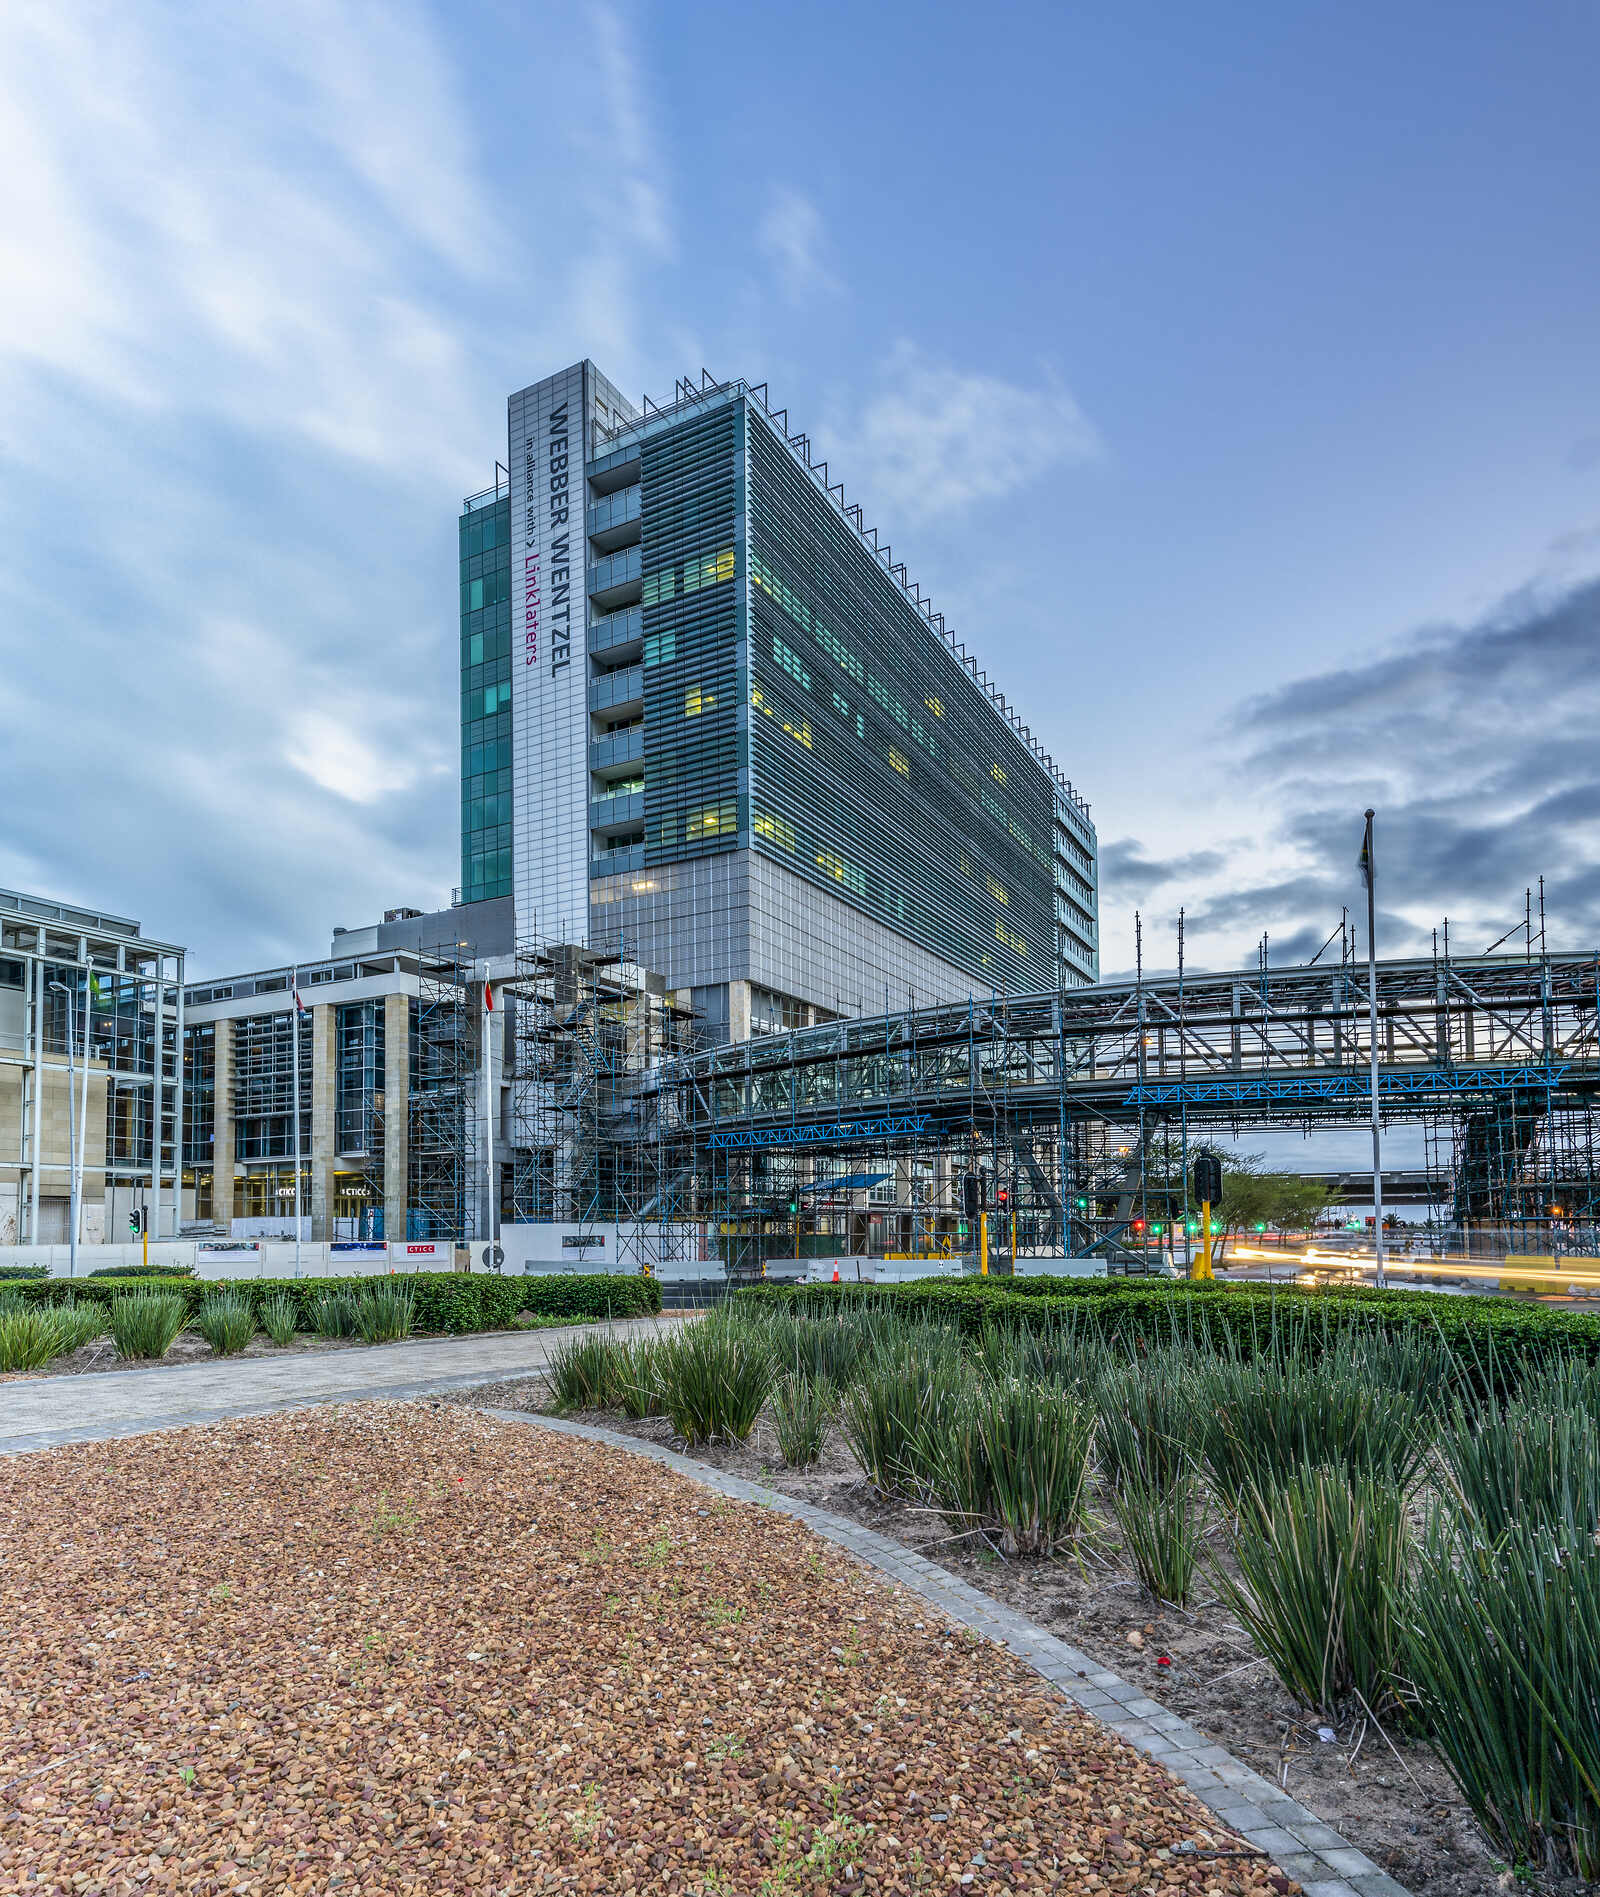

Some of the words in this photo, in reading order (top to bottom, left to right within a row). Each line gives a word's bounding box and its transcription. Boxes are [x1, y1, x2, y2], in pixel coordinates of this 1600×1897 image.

[526, 436, 535, 451] in
[526, 452, 536, 502] alliance
[550, 401, 569, 530] WEBBER
[527, 505, 536, 536] with
[525, 553, 541, 666] Linklaters
[551, 531, 570, 679] WENTZEL
